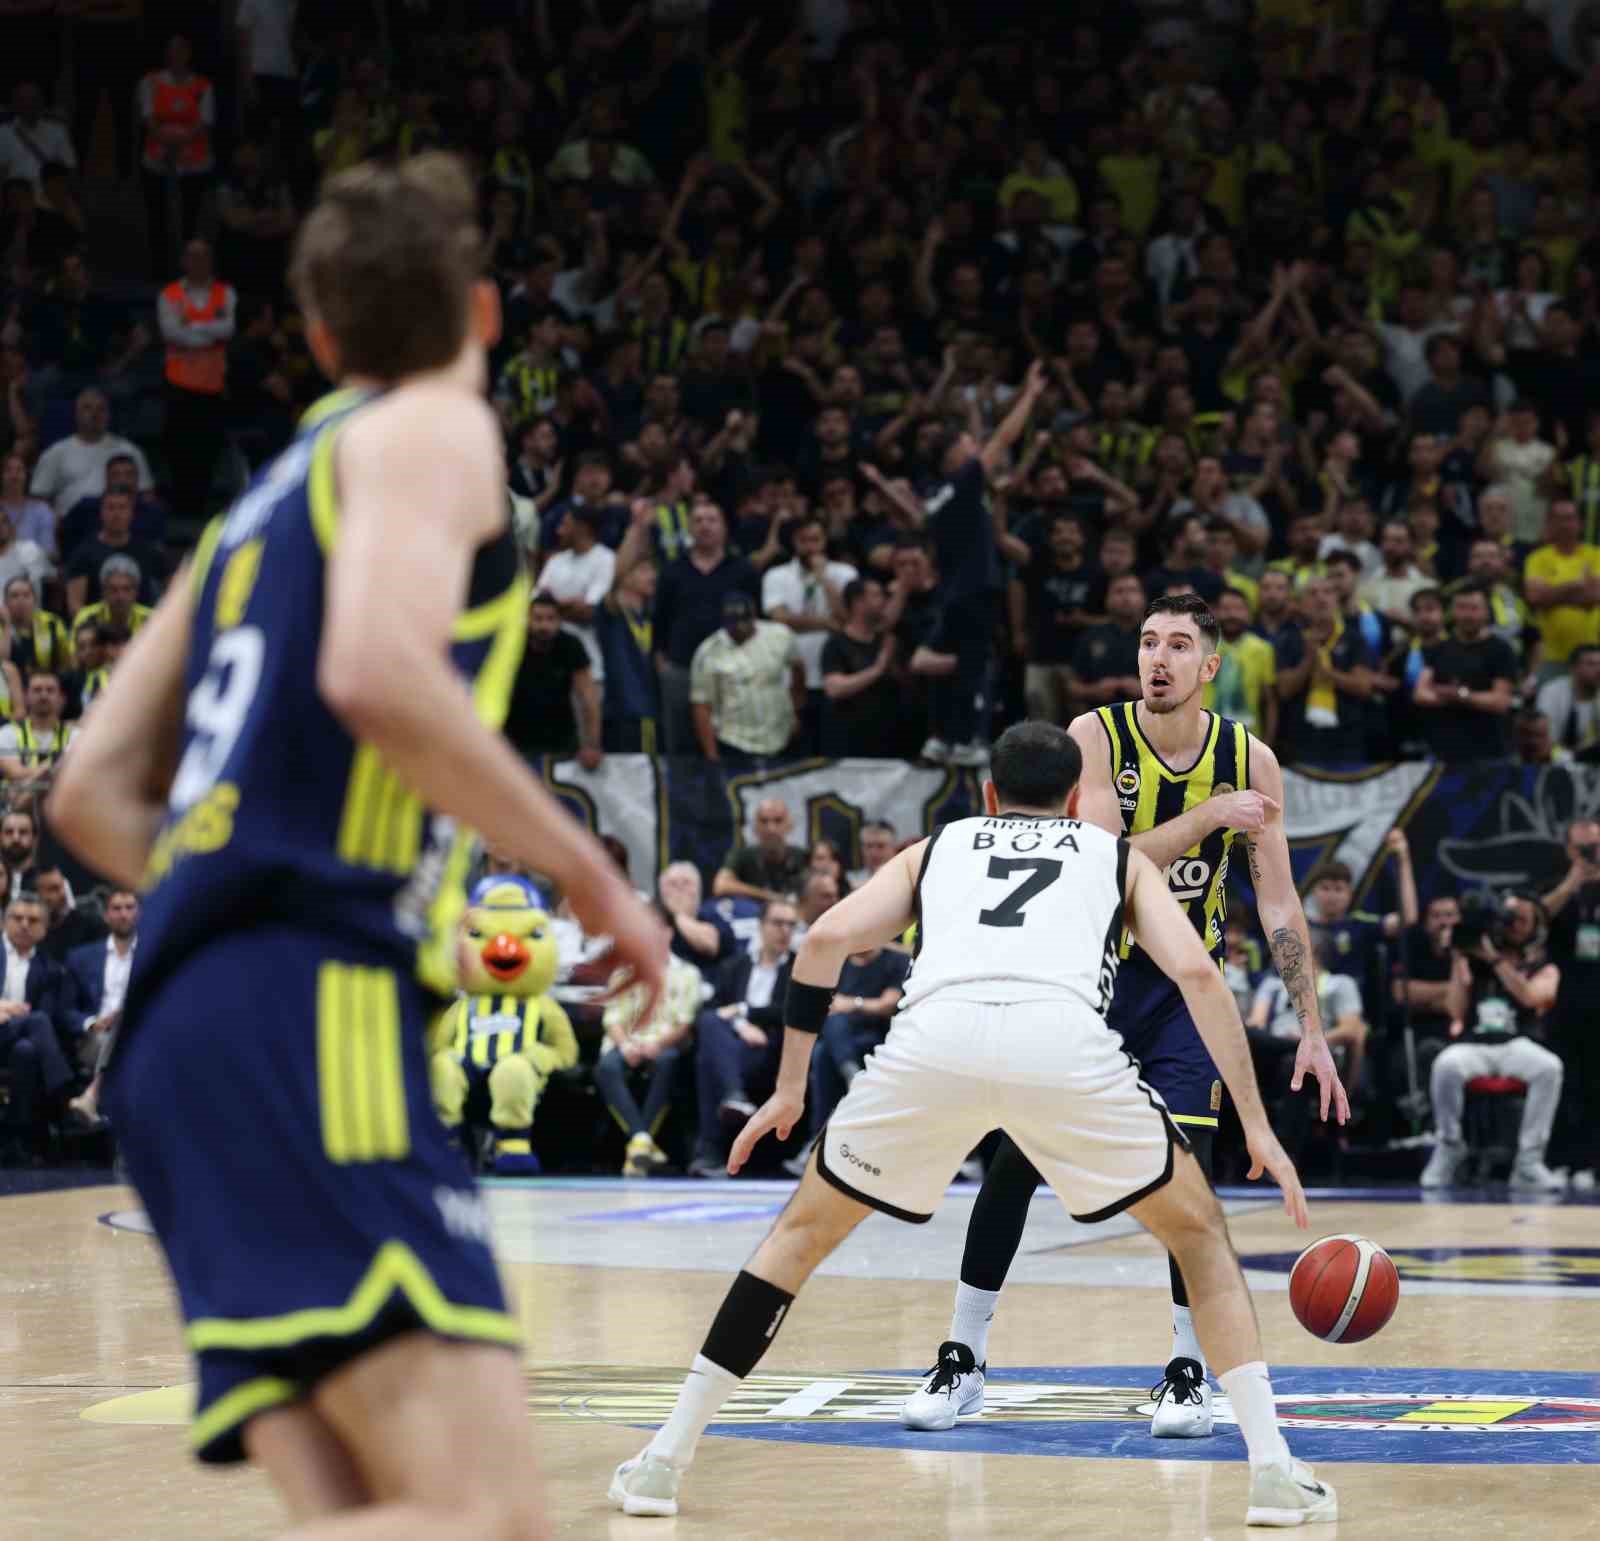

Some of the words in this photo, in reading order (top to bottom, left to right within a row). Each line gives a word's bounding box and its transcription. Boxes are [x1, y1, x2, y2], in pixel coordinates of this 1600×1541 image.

[1120, 797, 1137, 809] eko
[1168, 859, 1210, 887] KO
[978, 854, 1064, 928] 7
